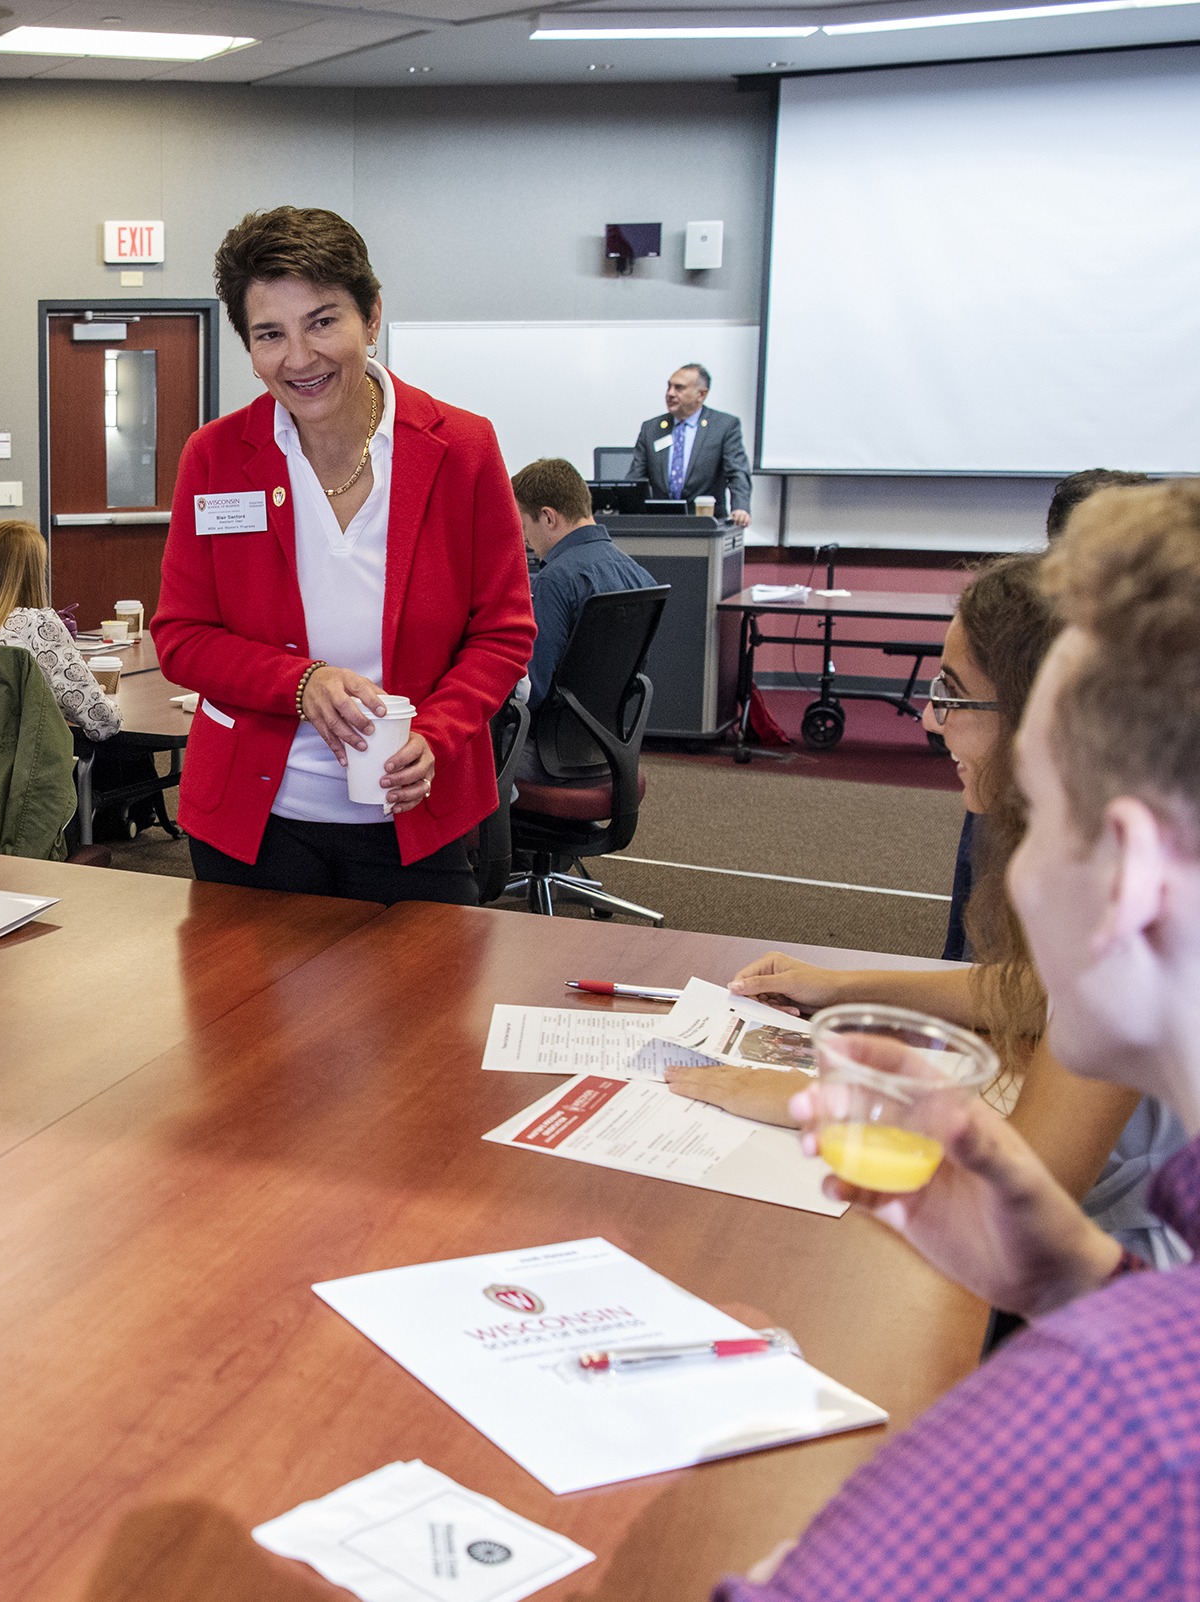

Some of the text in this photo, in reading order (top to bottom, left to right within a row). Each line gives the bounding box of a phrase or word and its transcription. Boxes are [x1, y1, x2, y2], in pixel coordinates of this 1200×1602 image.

[117, 226, 154, 257] EXIT
[207, 498, 240, 506] WISCONSIN
[464, 1305, 634, 1342] WISCONSIN
